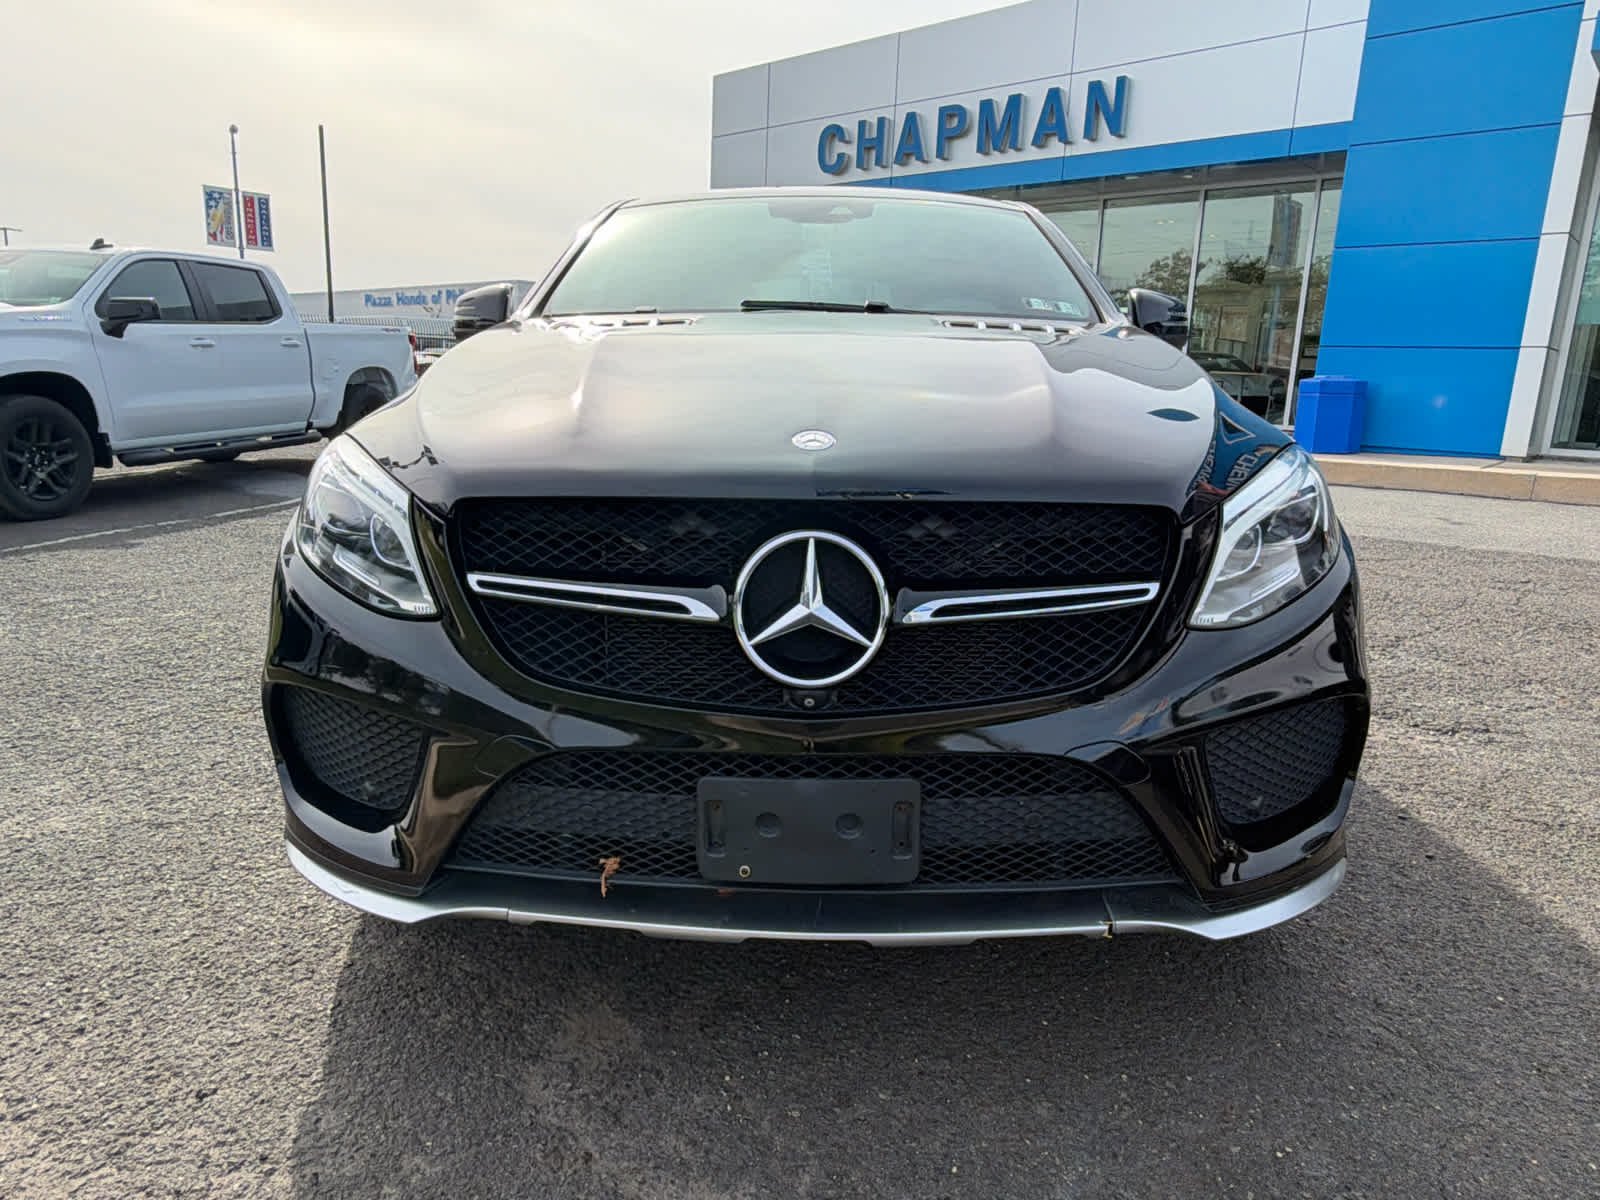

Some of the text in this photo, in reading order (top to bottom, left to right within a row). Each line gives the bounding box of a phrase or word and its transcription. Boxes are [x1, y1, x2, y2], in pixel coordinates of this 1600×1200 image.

[817, 75, 1130, 176] CHAPMAN
[396, 290, 428, 305] Honda
[432, 289, 442, 304] of
